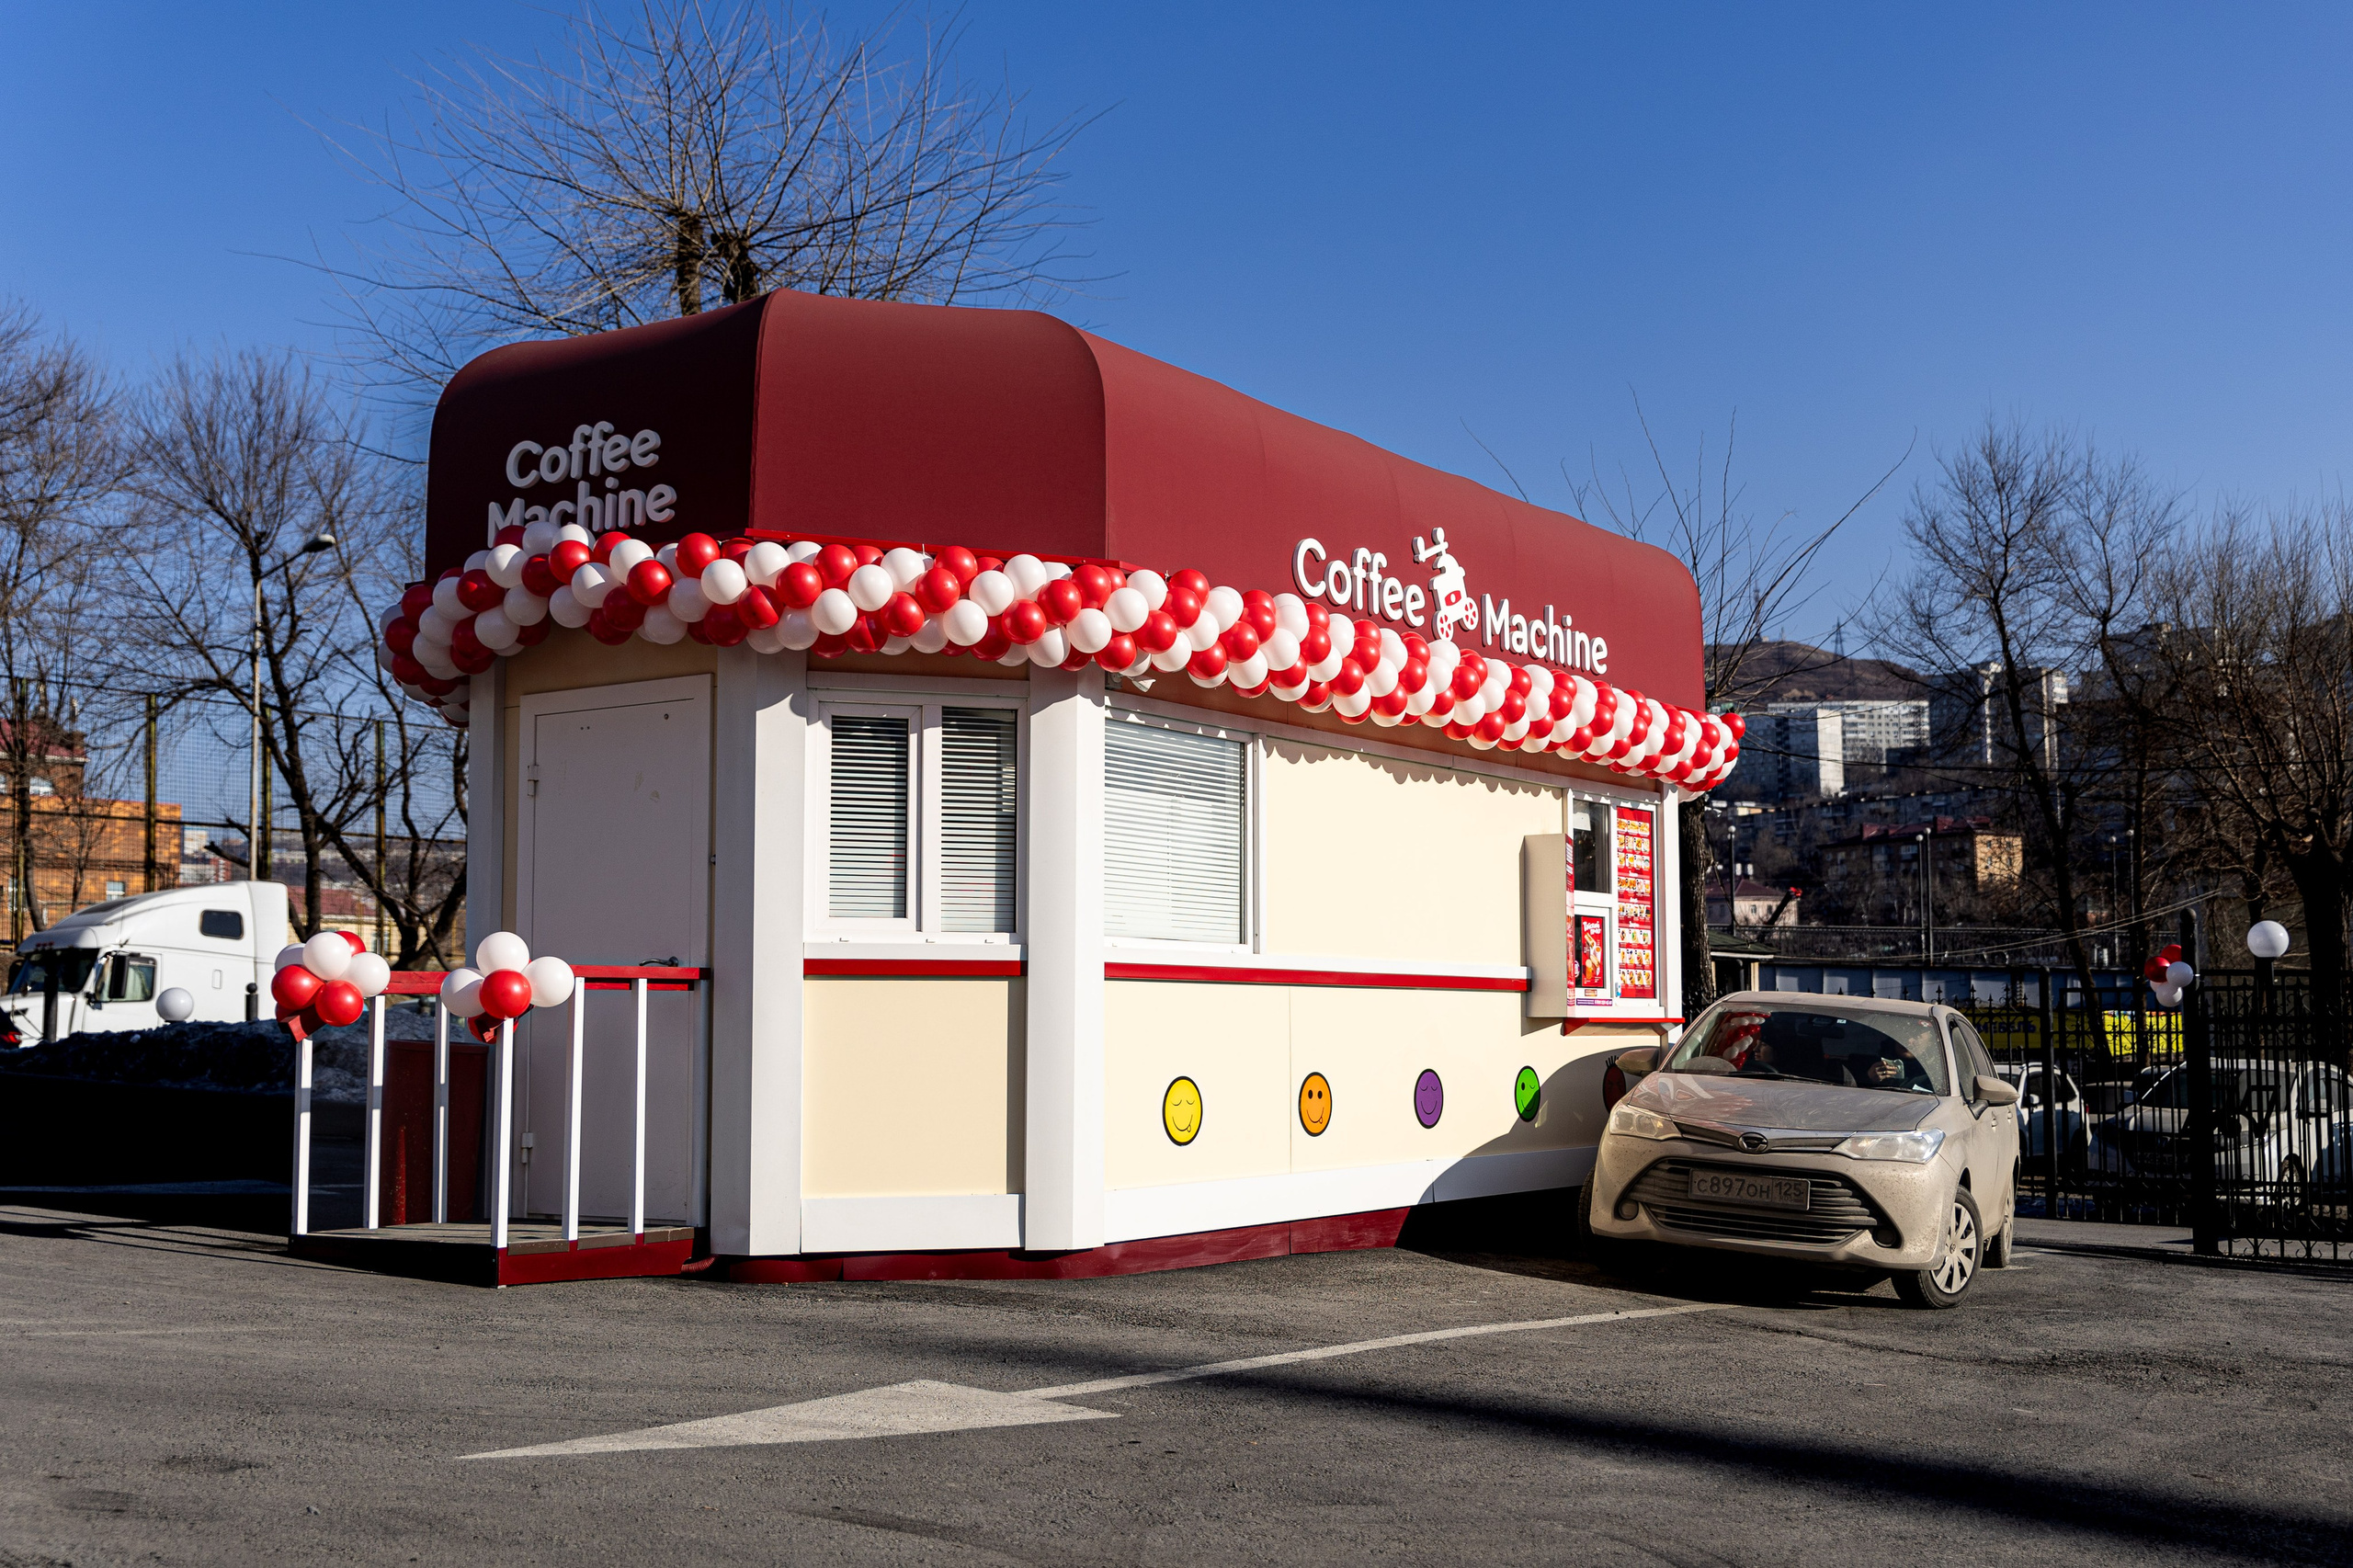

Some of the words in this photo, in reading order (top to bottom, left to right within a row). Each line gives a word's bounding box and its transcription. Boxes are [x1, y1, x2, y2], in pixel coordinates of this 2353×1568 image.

[506, 420, 662, 488] Coffee
[1291, 538, 1426, 628] Coffee
[1481, 593, 1608, 676] Machine
[1775, 1180, 1802, 1197] 125
